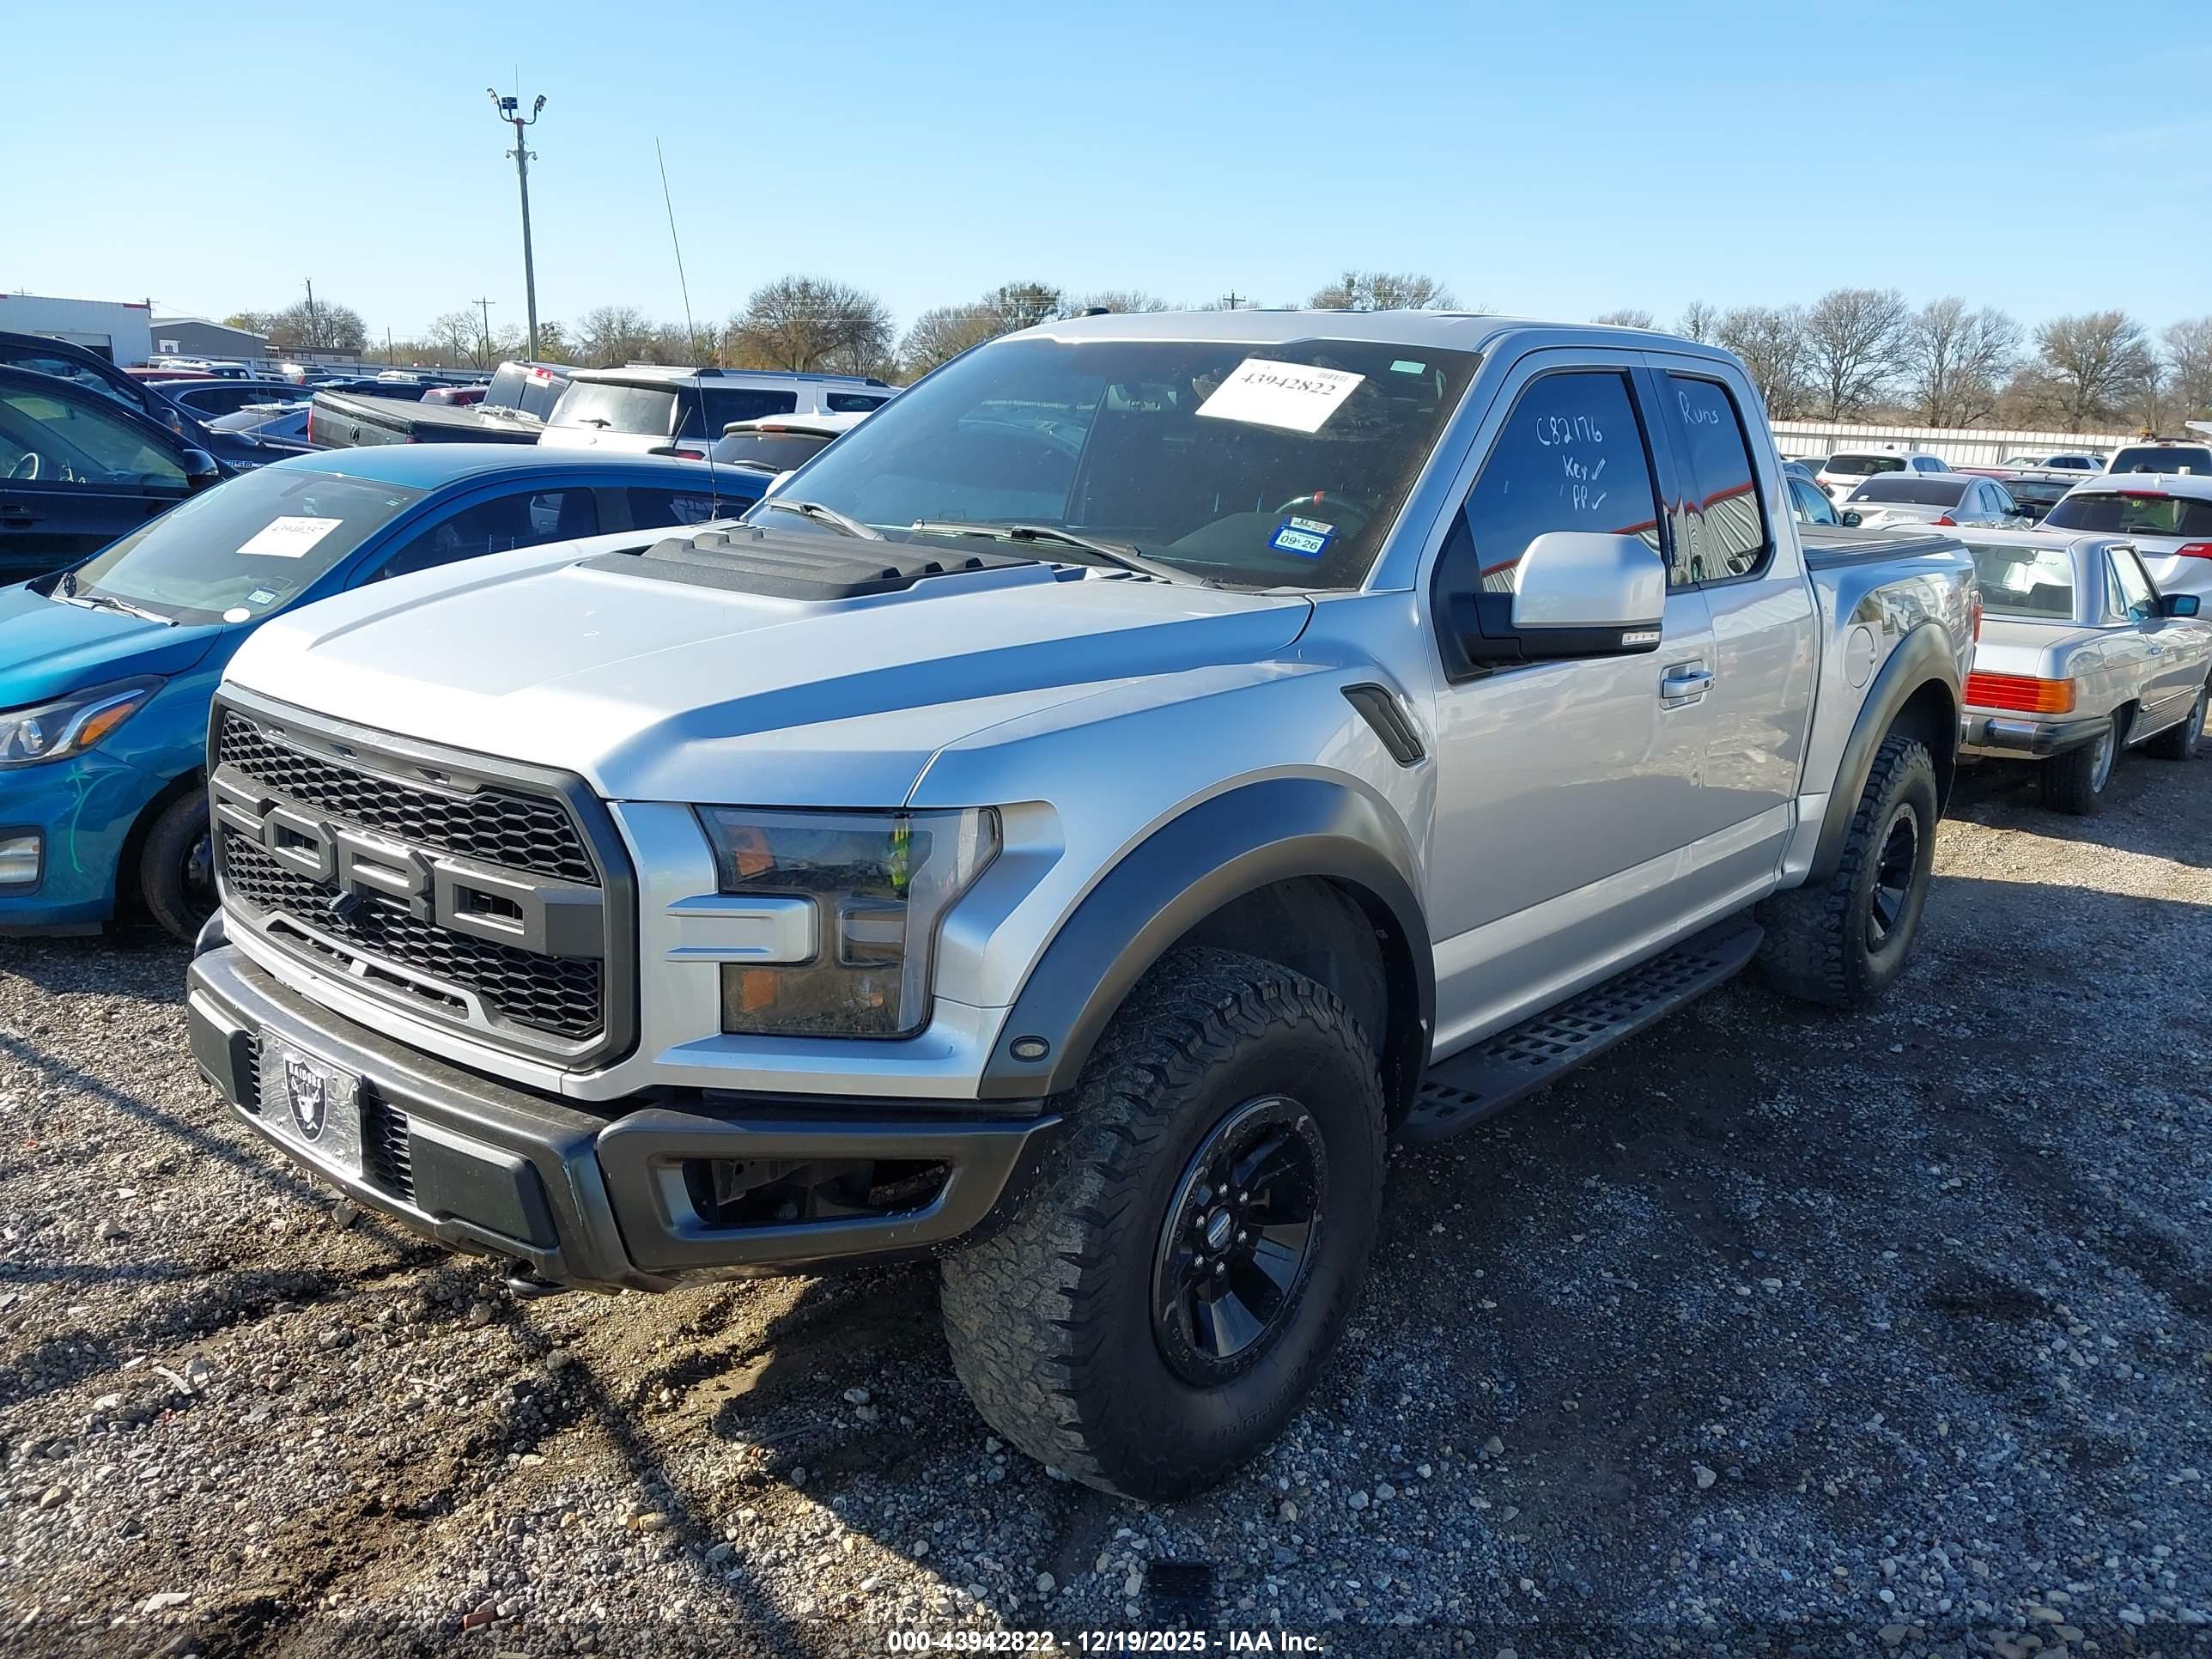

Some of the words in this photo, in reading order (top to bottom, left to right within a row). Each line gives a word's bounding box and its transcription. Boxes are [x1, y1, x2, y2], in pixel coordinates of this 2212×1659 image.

[1241, 372, 1337, 396] 43942822
[1677, 390, 1719, 425] Runs
[1536, 416, 1603, 446] C82176
[1562, 453, 1589, 481] Key
[209, 763, 554, 956] FORD
[288, 1061, 323, 1090] RAIDERS
